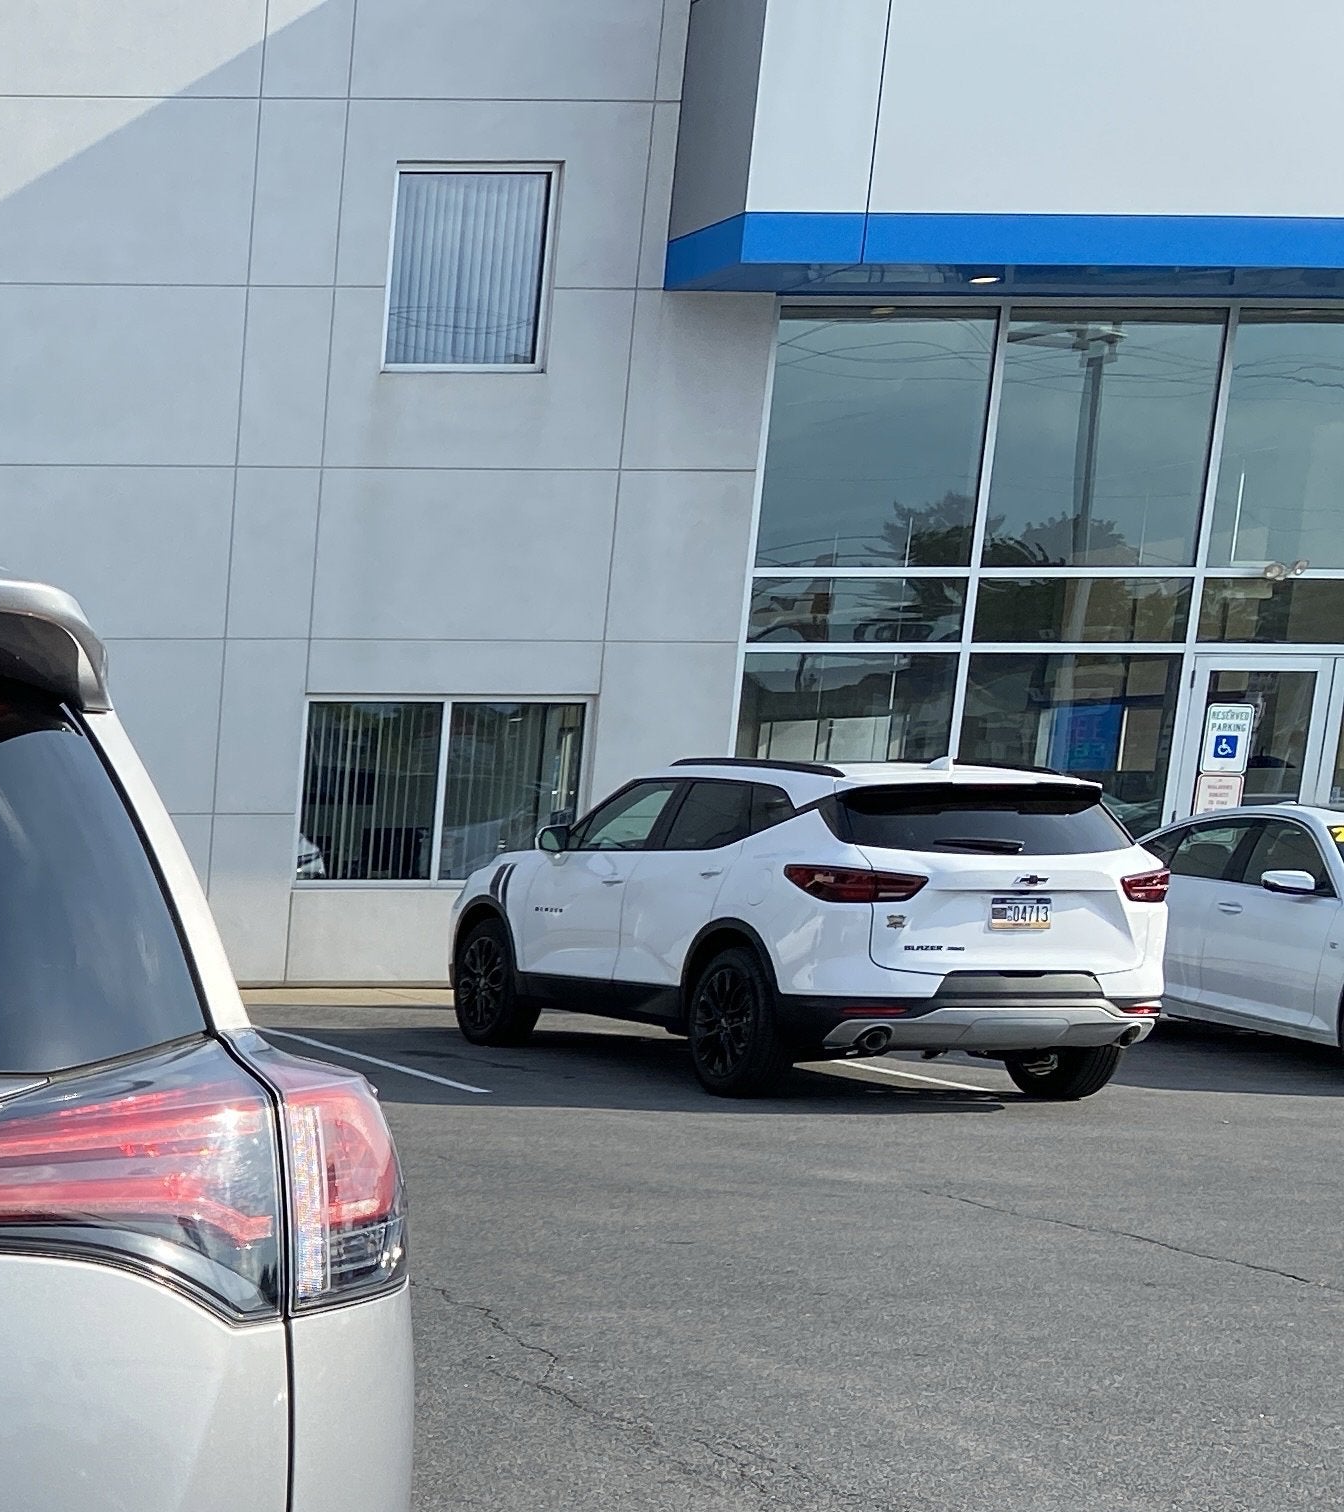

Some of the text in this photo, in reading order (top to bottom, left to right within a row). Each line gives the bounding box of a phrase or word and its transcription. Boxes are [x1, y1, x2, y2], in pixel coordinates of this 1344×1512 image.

[1212, 711, 1249, 720] RESERVED
[1211, 722, 1246, 732] PARKING
[1013, 905, 1049, 922] 04713
